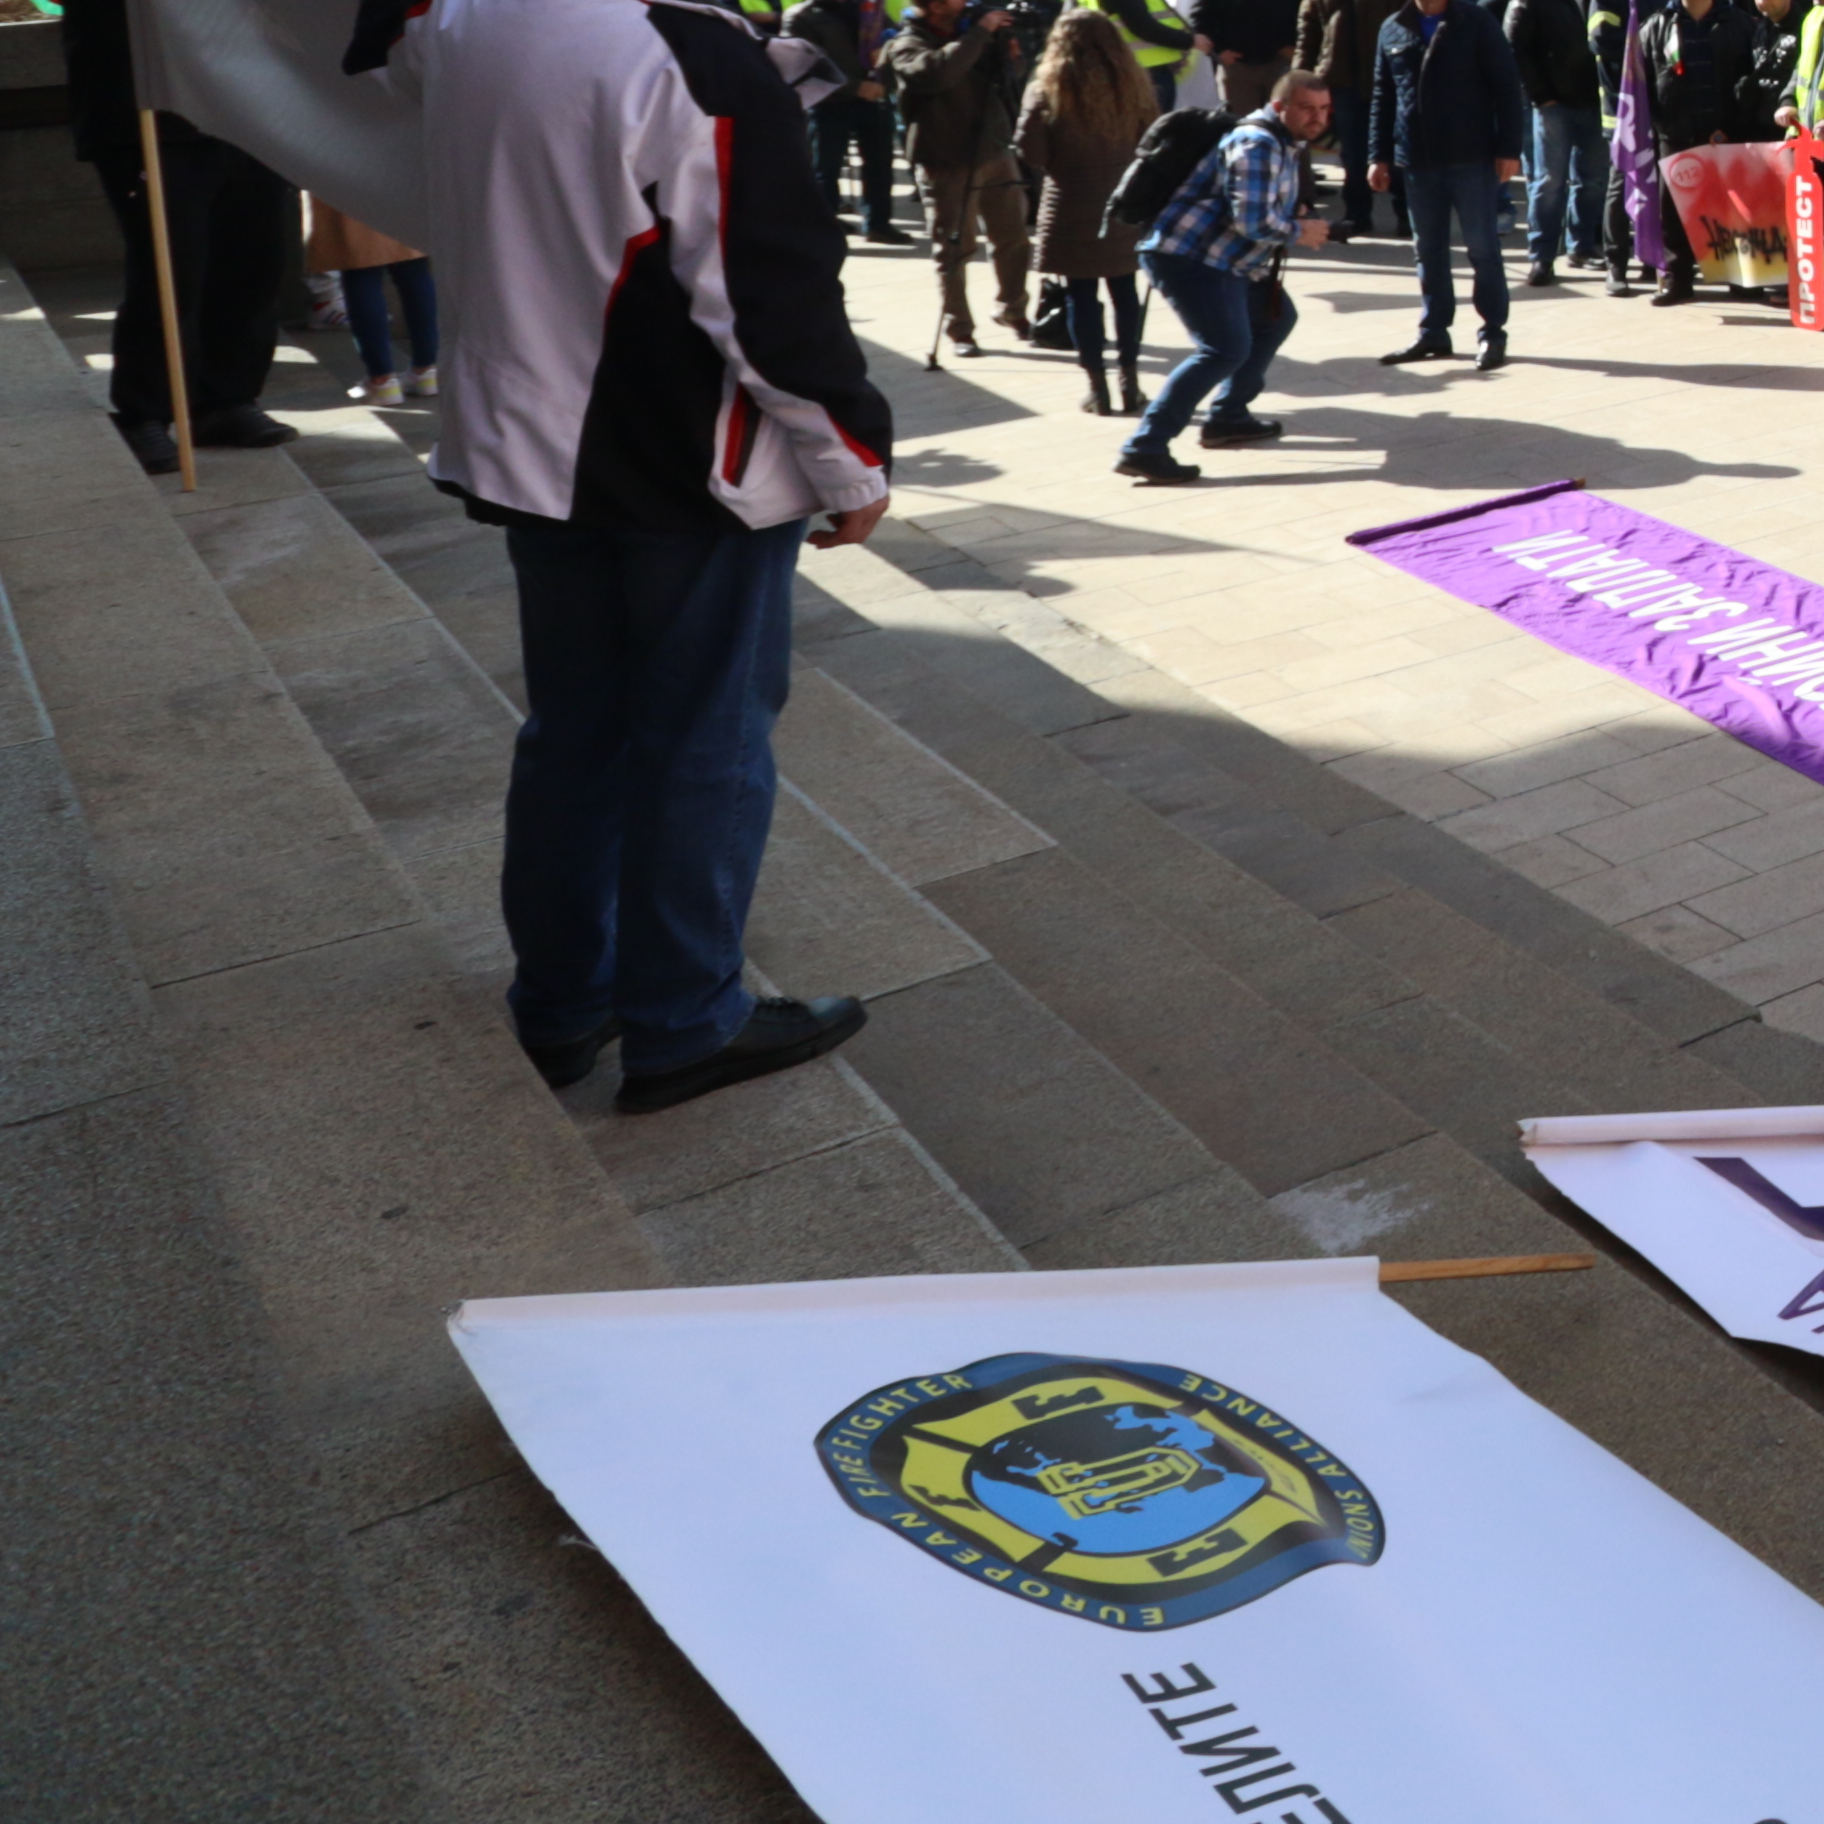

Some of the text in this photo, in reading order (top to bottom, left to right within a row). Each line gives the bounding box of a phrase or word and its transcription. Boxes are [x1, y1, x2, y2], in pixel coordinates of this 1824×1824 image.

[1795, 175, 1816, 325] ПРОТЕСТ
[1491, 528, 1748, 633] ЗАПЛАТИ
[891, 1510, 1164, 1627] EUROPEAN
[1179, 1372, 1348, 1478] ALLIANCE
[1120, 1662, 1354, 1824] ЕЛИТЕ
